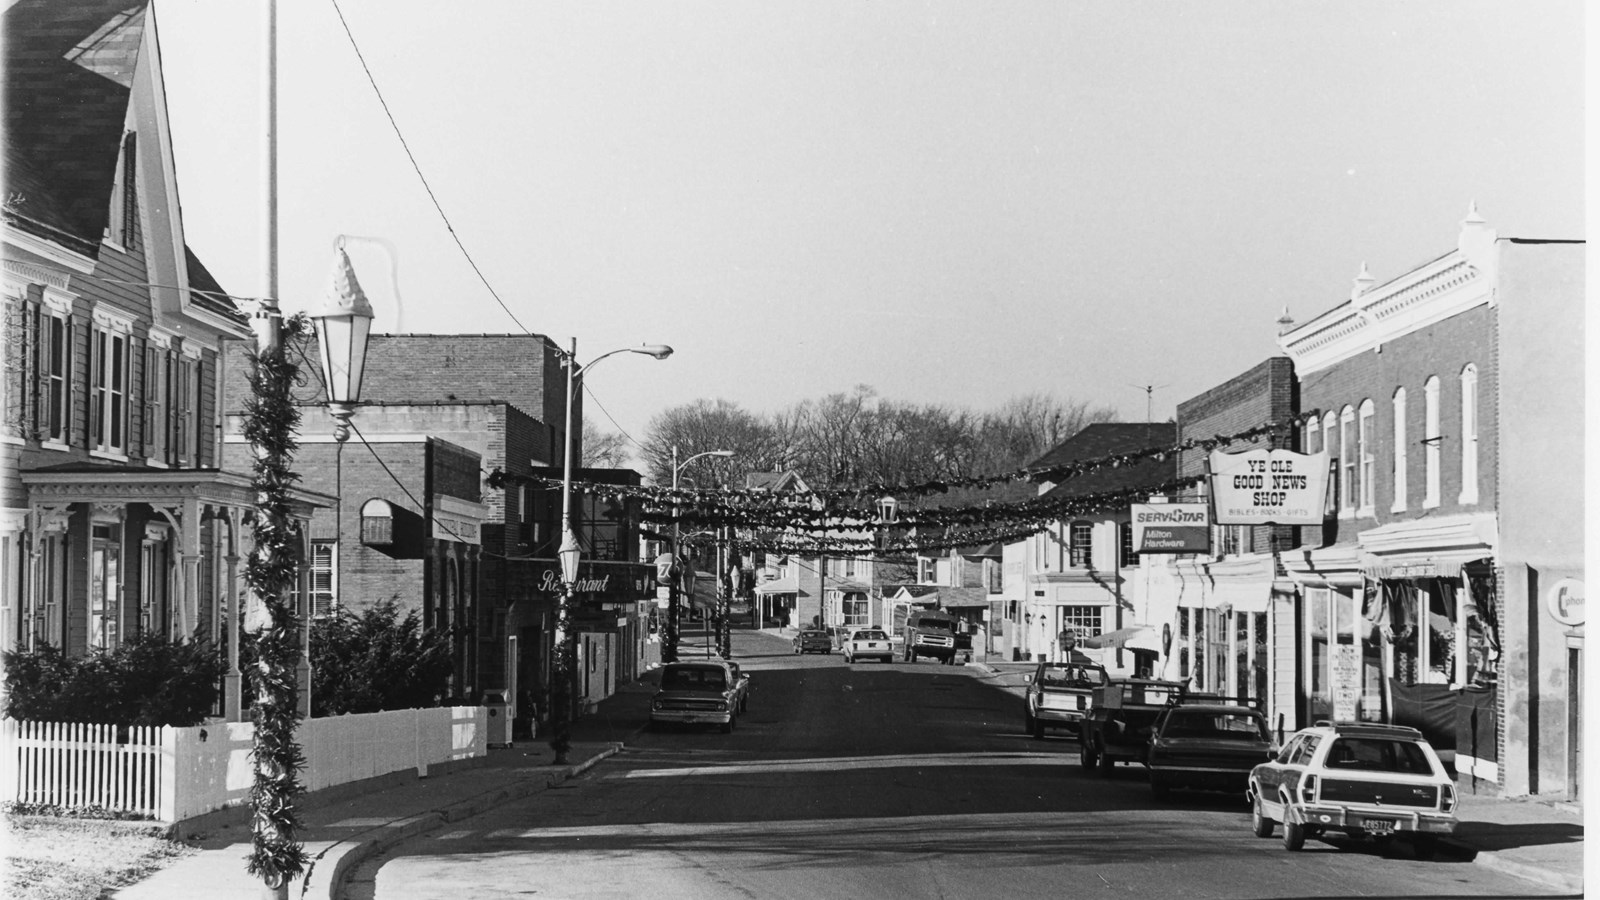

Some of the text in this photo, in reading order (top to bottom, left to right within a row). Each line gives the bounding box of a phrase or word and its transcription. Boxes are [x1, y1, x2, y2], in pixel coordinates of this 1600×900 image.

[1248, 460, 1293, 473] YE OLE
[1233, 475, 1307, 490] GOOD NEWS
[1253, 492, 1286, 507] SHOP
[1137, 508, 1205, 523] SERVISTAR
[1146, 530, 1172, 538] Milton
[1144, 539, 1185, 548] Hardware
[537, 569, 610, 592] Reurant
